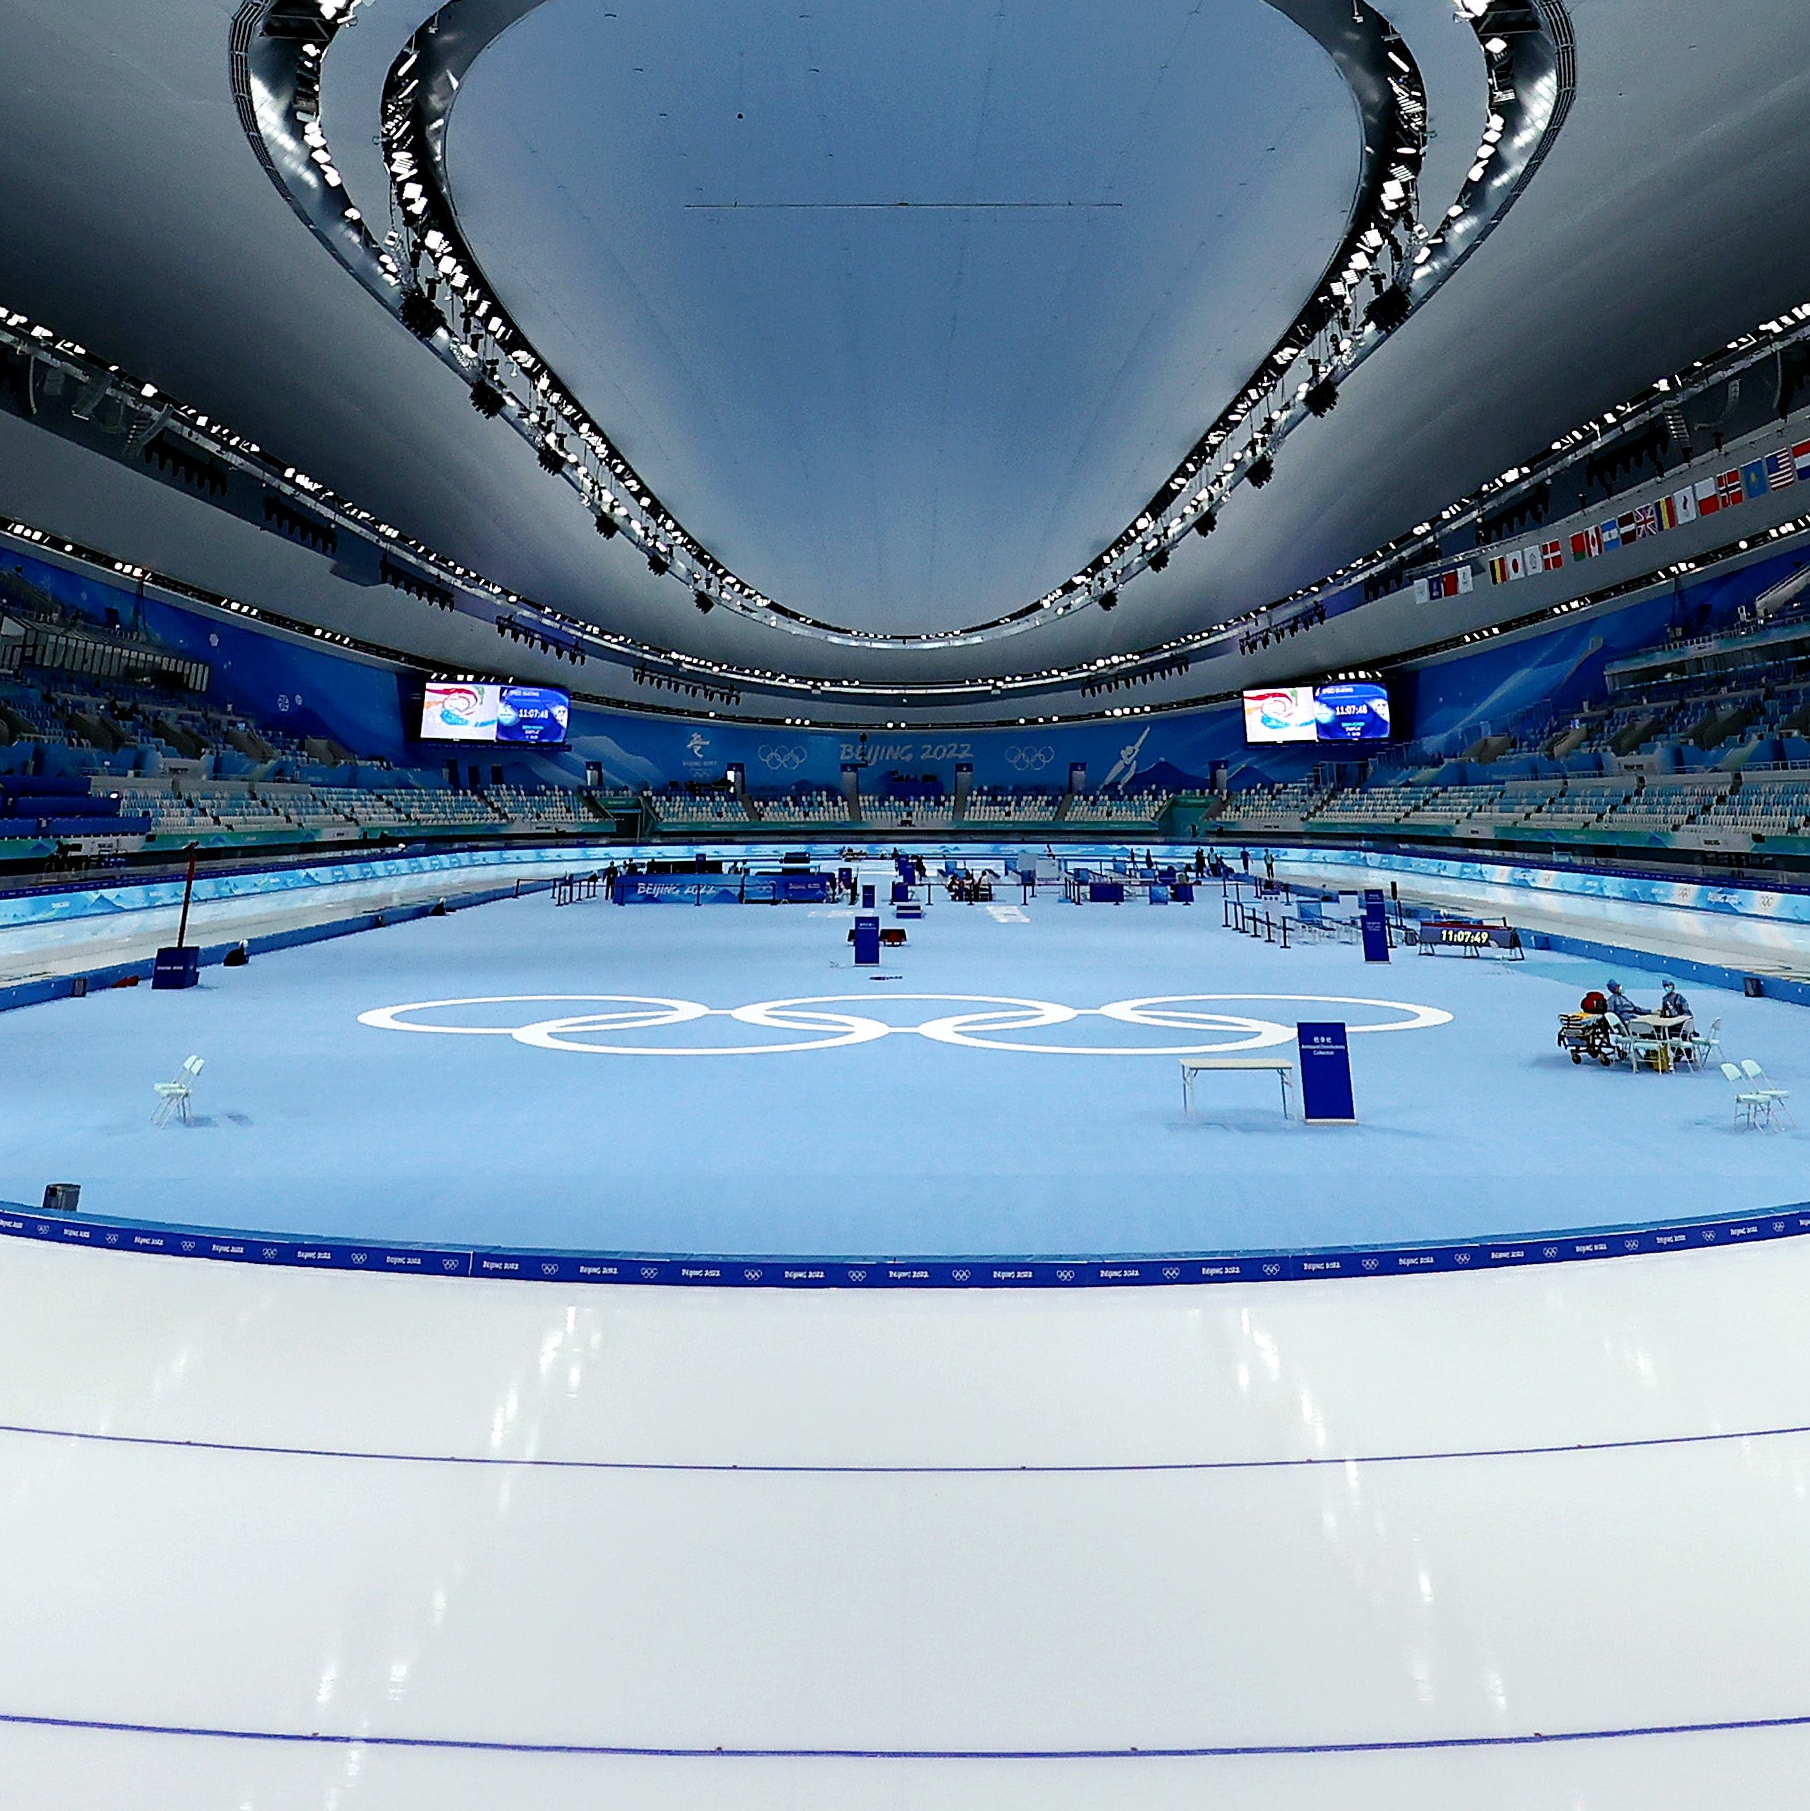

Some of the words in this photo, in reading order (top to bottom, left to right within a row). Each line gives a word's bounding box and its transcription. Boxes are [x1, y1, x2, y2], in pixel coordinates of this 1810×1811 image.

[840, 744, 914, 766] BEIJING
[921, 744, 975, 761] 2022
[638, 883, 680, 898] BEIJING
[685, 884, 715, 895] 2022
[1442, 930, 1489, 944] 11:07:49
